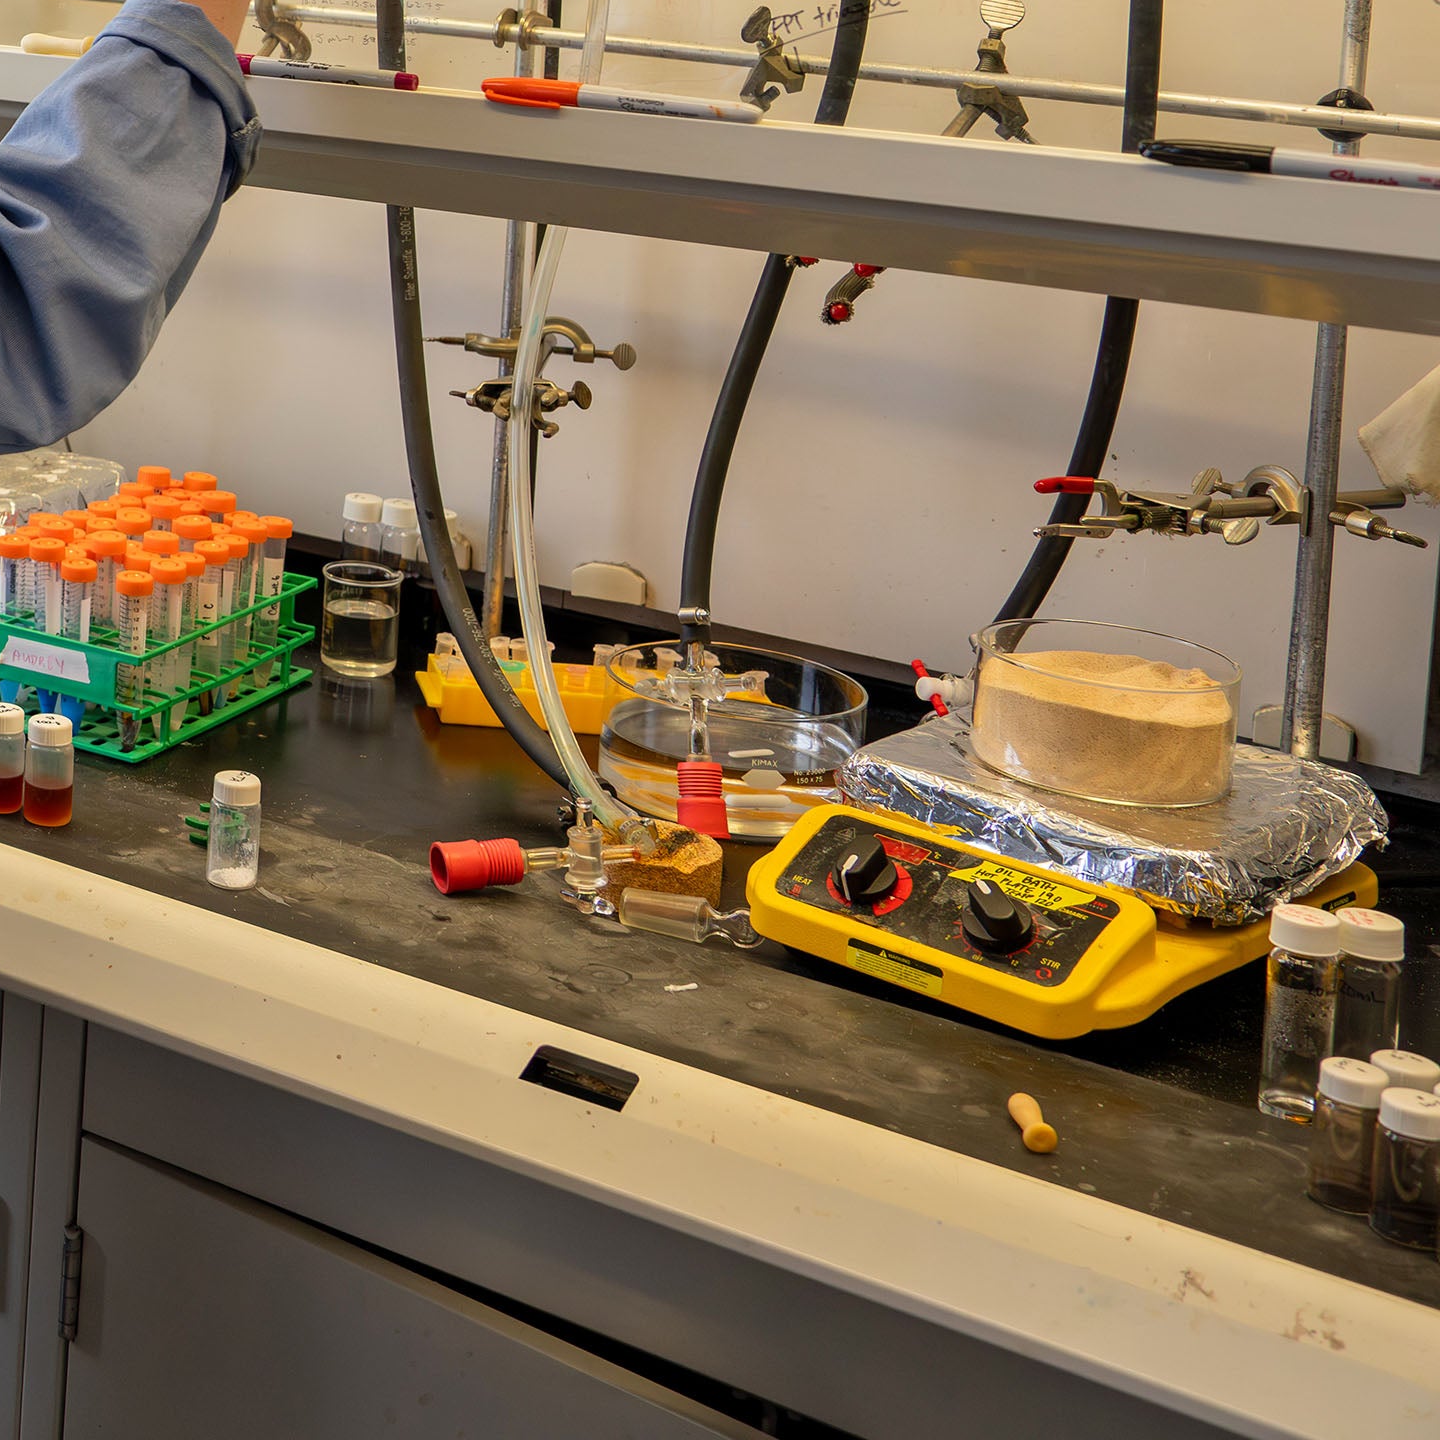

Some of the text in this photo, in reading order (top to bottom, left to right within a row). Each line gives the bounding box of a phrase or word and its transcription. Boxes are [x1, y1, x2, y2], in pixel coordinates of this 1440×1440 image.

[11, 648, 66, 674] AUDREY
[751, 759, 779, 768] KIMAX
[792, 874, 814, 886] HEAT
[995, 867, 1058, 891] OIL BATH
[1039, 957, 1062, 970] STIR
